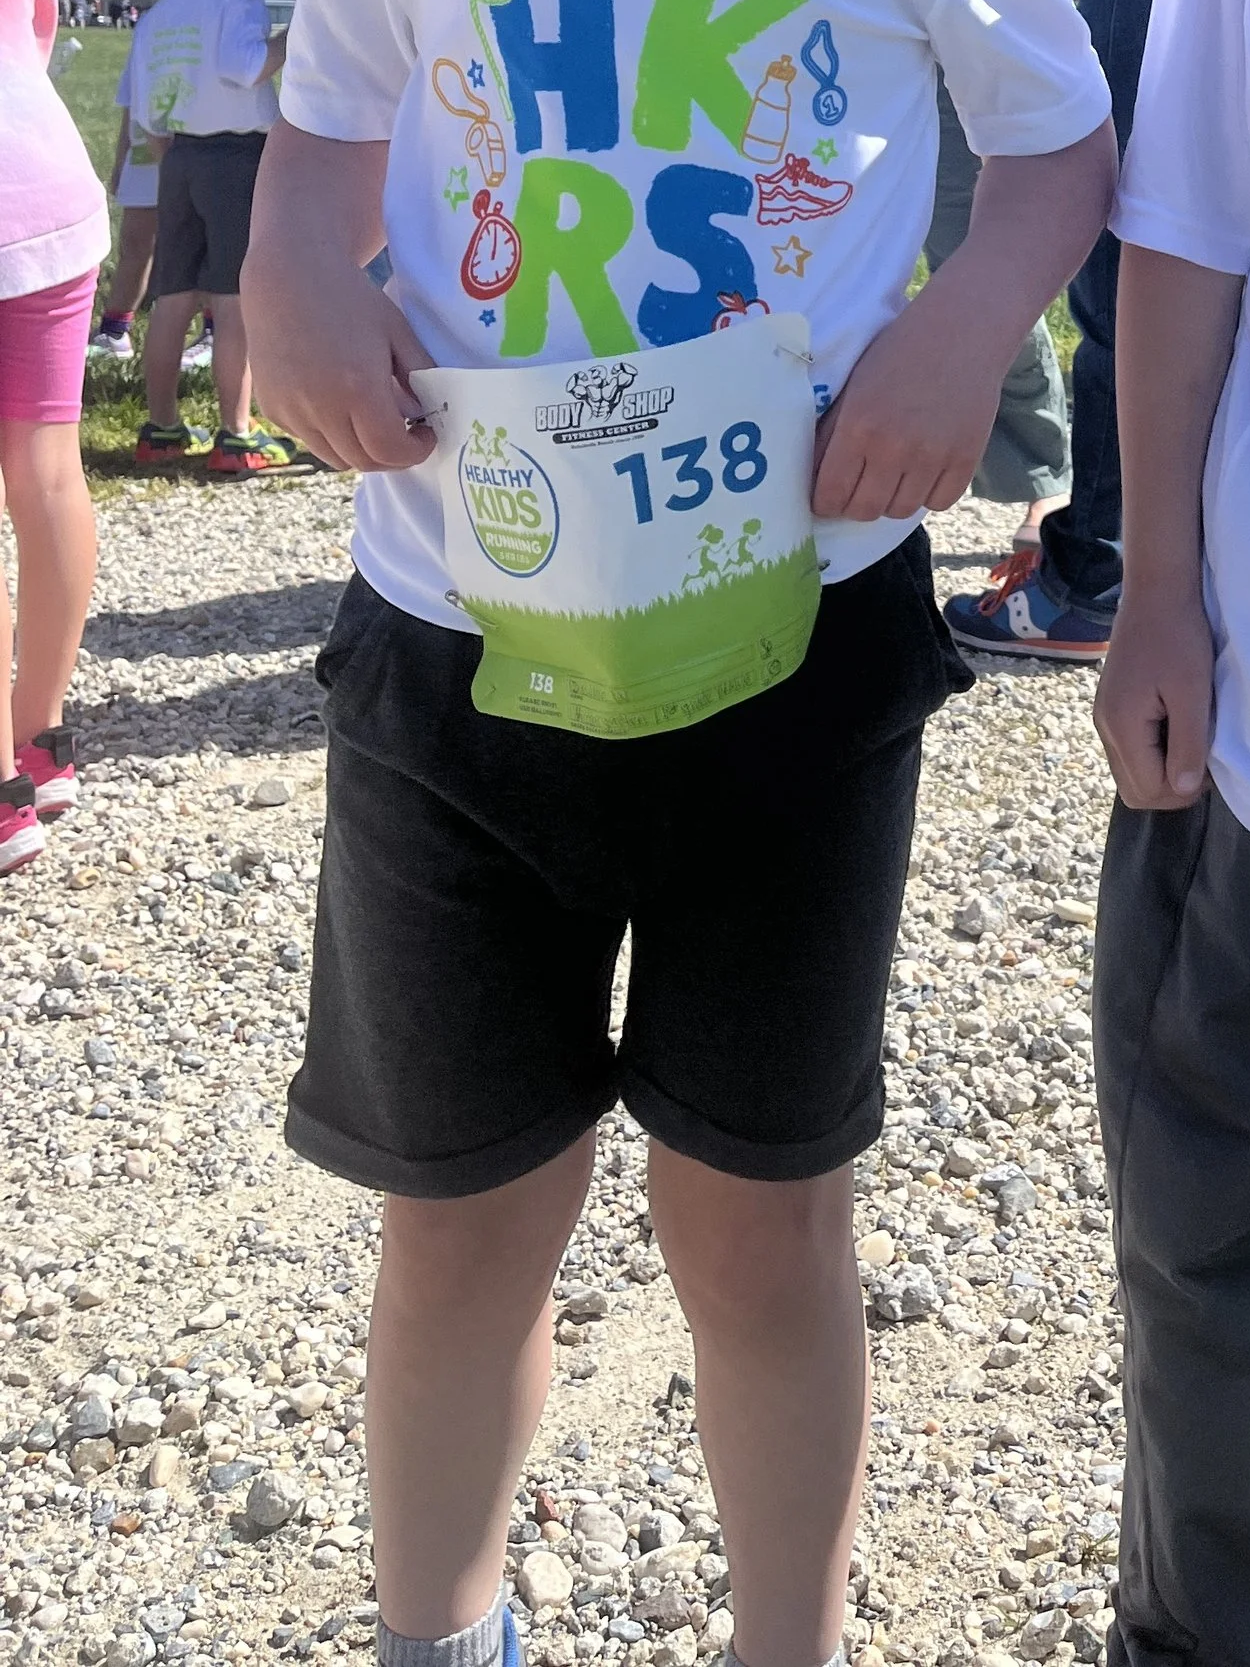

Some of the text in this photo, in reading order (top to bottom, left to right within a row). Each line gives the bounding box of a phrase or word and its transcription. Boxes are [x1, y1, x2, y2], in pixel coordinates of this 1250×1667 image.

[535, 386, 674, 432] BODY SHOP
[562, 428, 605, 442] FITNESS
[606, 422, 650, 436] CENTER
[465, 463, 533, 488] HEALTHY
[613, 421, 768, 524] 138
[468, 483, 542, 528] KIDS
[485, 532, 542, 555] RUNNING
[530, 672, 554, 694] 138
